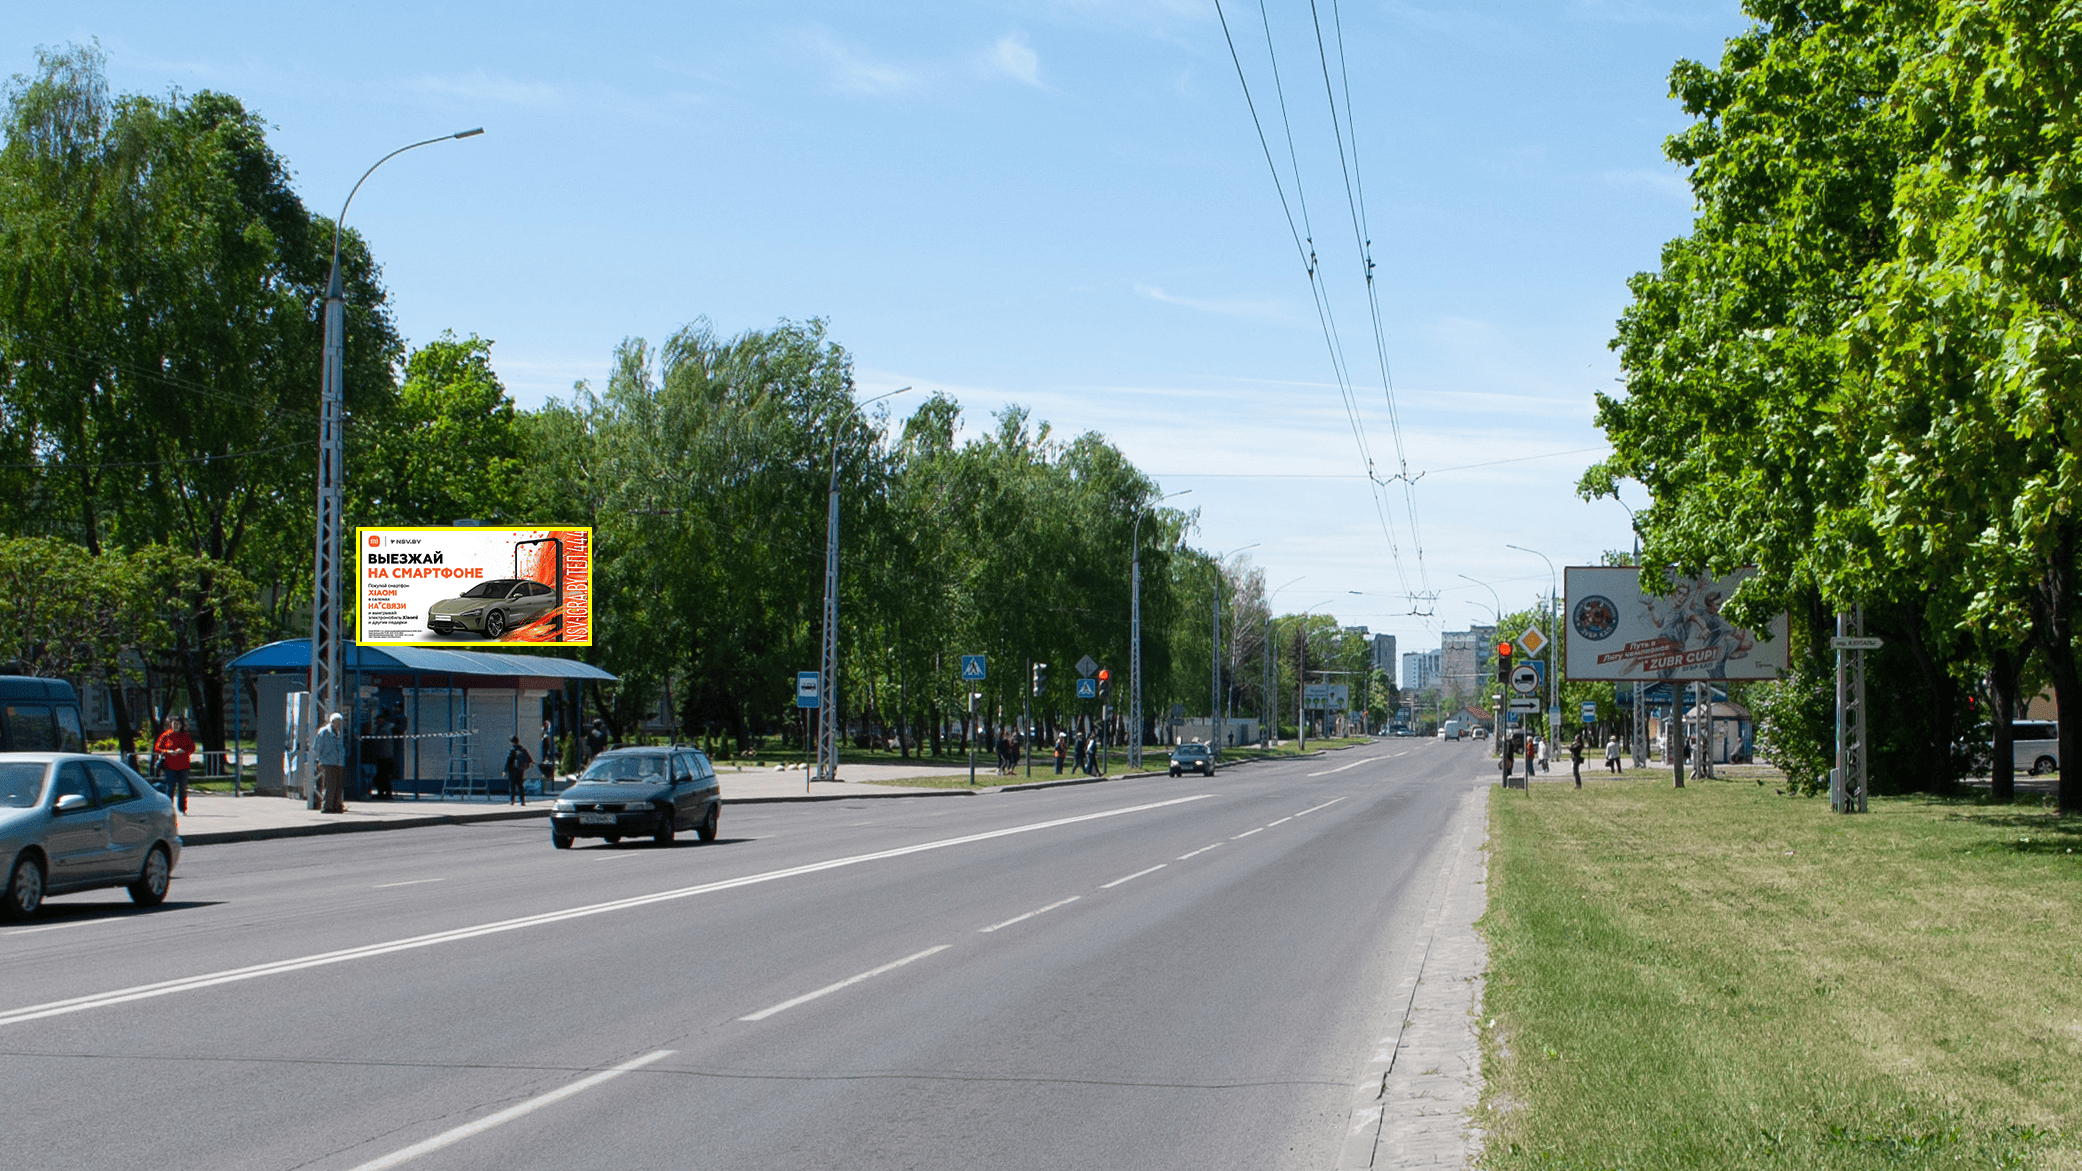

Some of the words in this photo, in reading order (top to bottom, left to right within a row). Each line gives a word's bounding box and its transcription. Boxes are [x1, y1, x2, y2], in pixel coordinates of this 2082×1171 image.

[368, 551, 443, 564] ВЫЕЗЖАЙ
[368, 568, 389, 578] НА
[392, 567, 484, 579] СМАРТФОНЕ
[566, 578, 588, 642] NSV-IGRA.BY
[1630, 641, 1650, 650] Путь
[1650, 655, 1684, 670] ZUBR
[1686, 648, 1717, 664] CUP!
